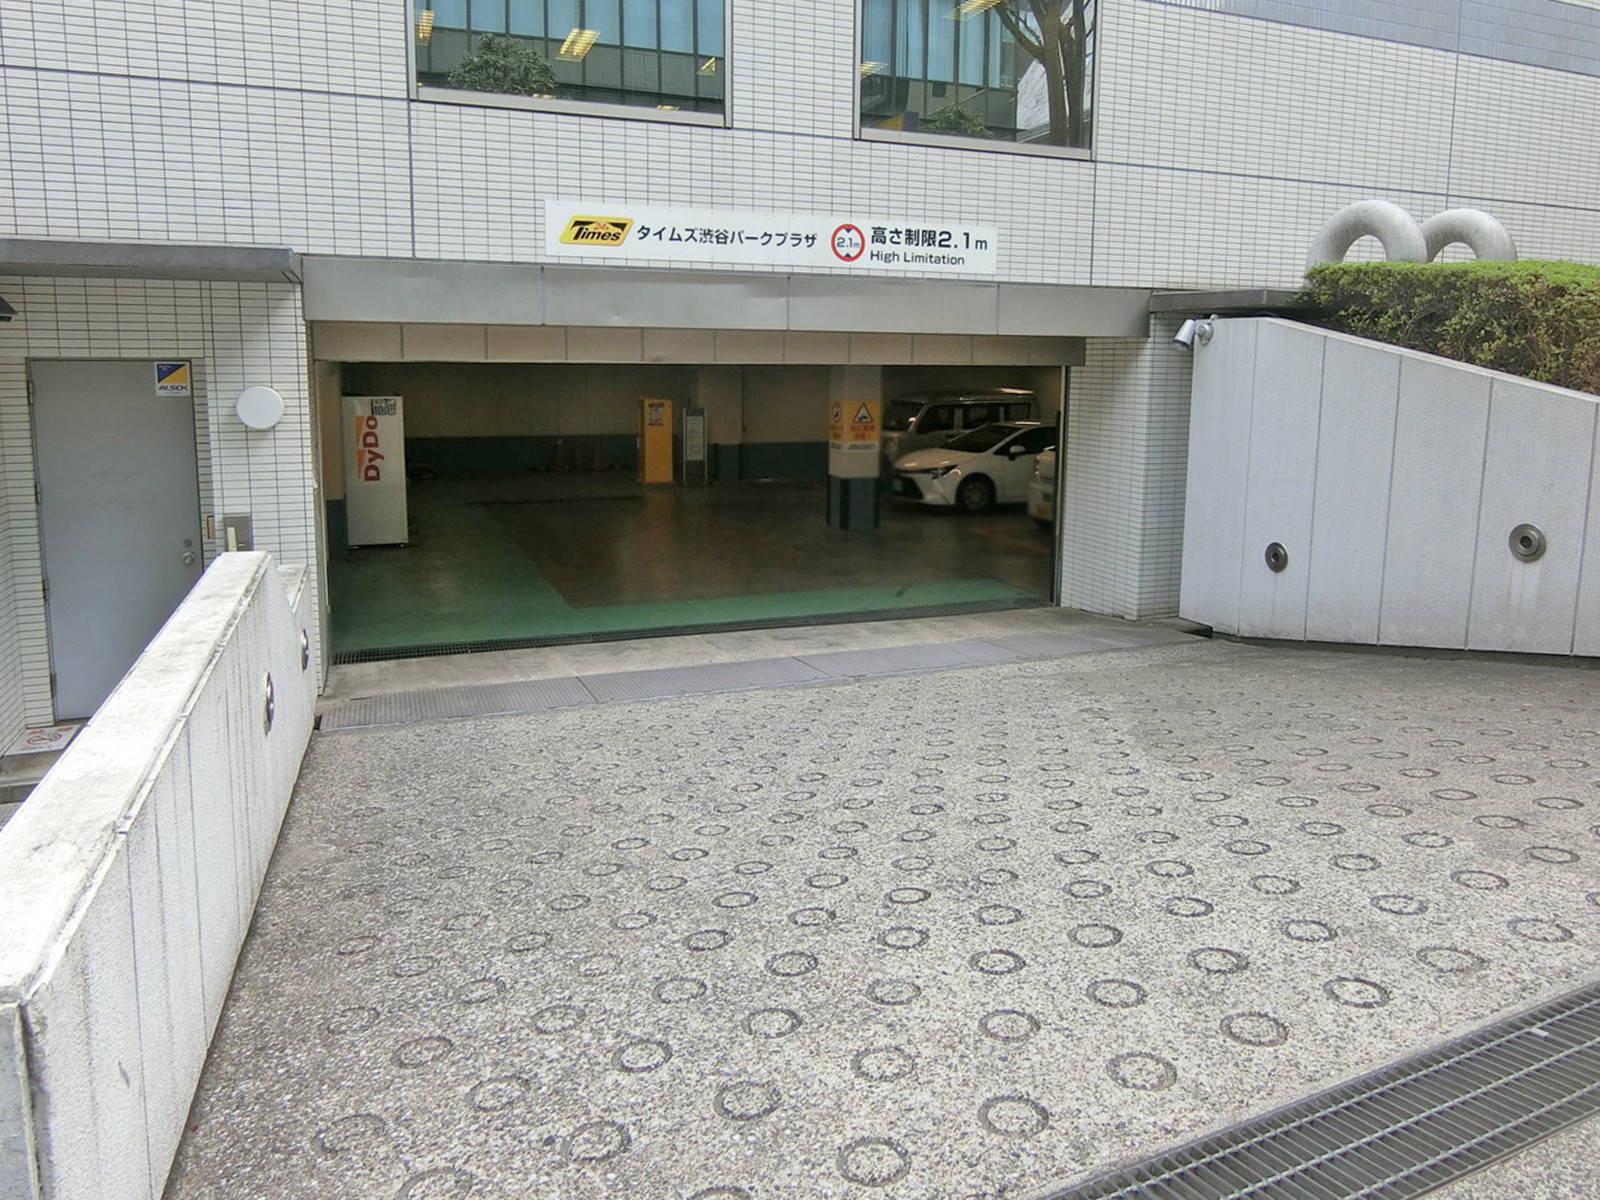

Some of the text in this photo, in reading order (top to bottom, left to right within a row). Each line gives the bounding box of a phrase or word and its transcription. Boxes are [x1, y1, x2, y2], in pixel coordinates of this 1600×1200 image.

[570, 220, 627, 241] Times
[637, 225, 818, 248] タイムズ渋谷パークプラザ
[870, 250, 966, 266] High Limitation
[363, 415, 384, 481] DyDo
